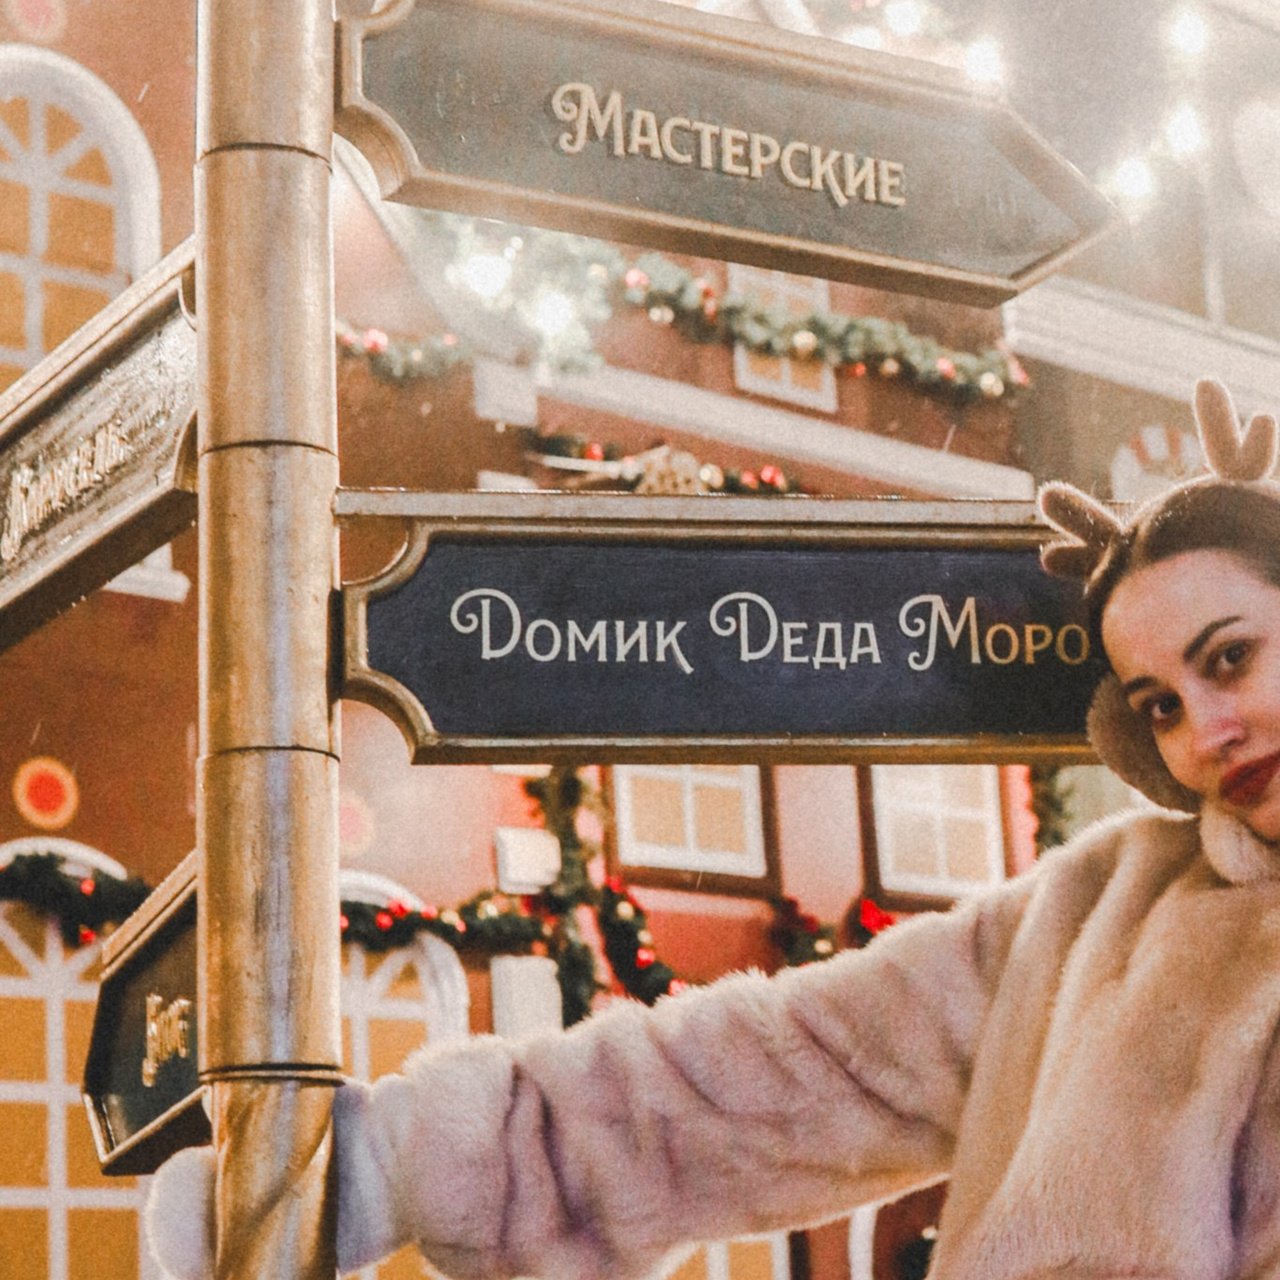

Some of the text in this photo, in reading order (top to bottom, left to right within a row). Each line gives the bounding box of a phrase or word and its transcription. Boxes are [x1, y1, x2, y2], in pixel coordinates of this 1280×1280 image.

[551, 81, 906, 208] Мастерские
[450, 587, 1091, 674] Домик Деда Моро
